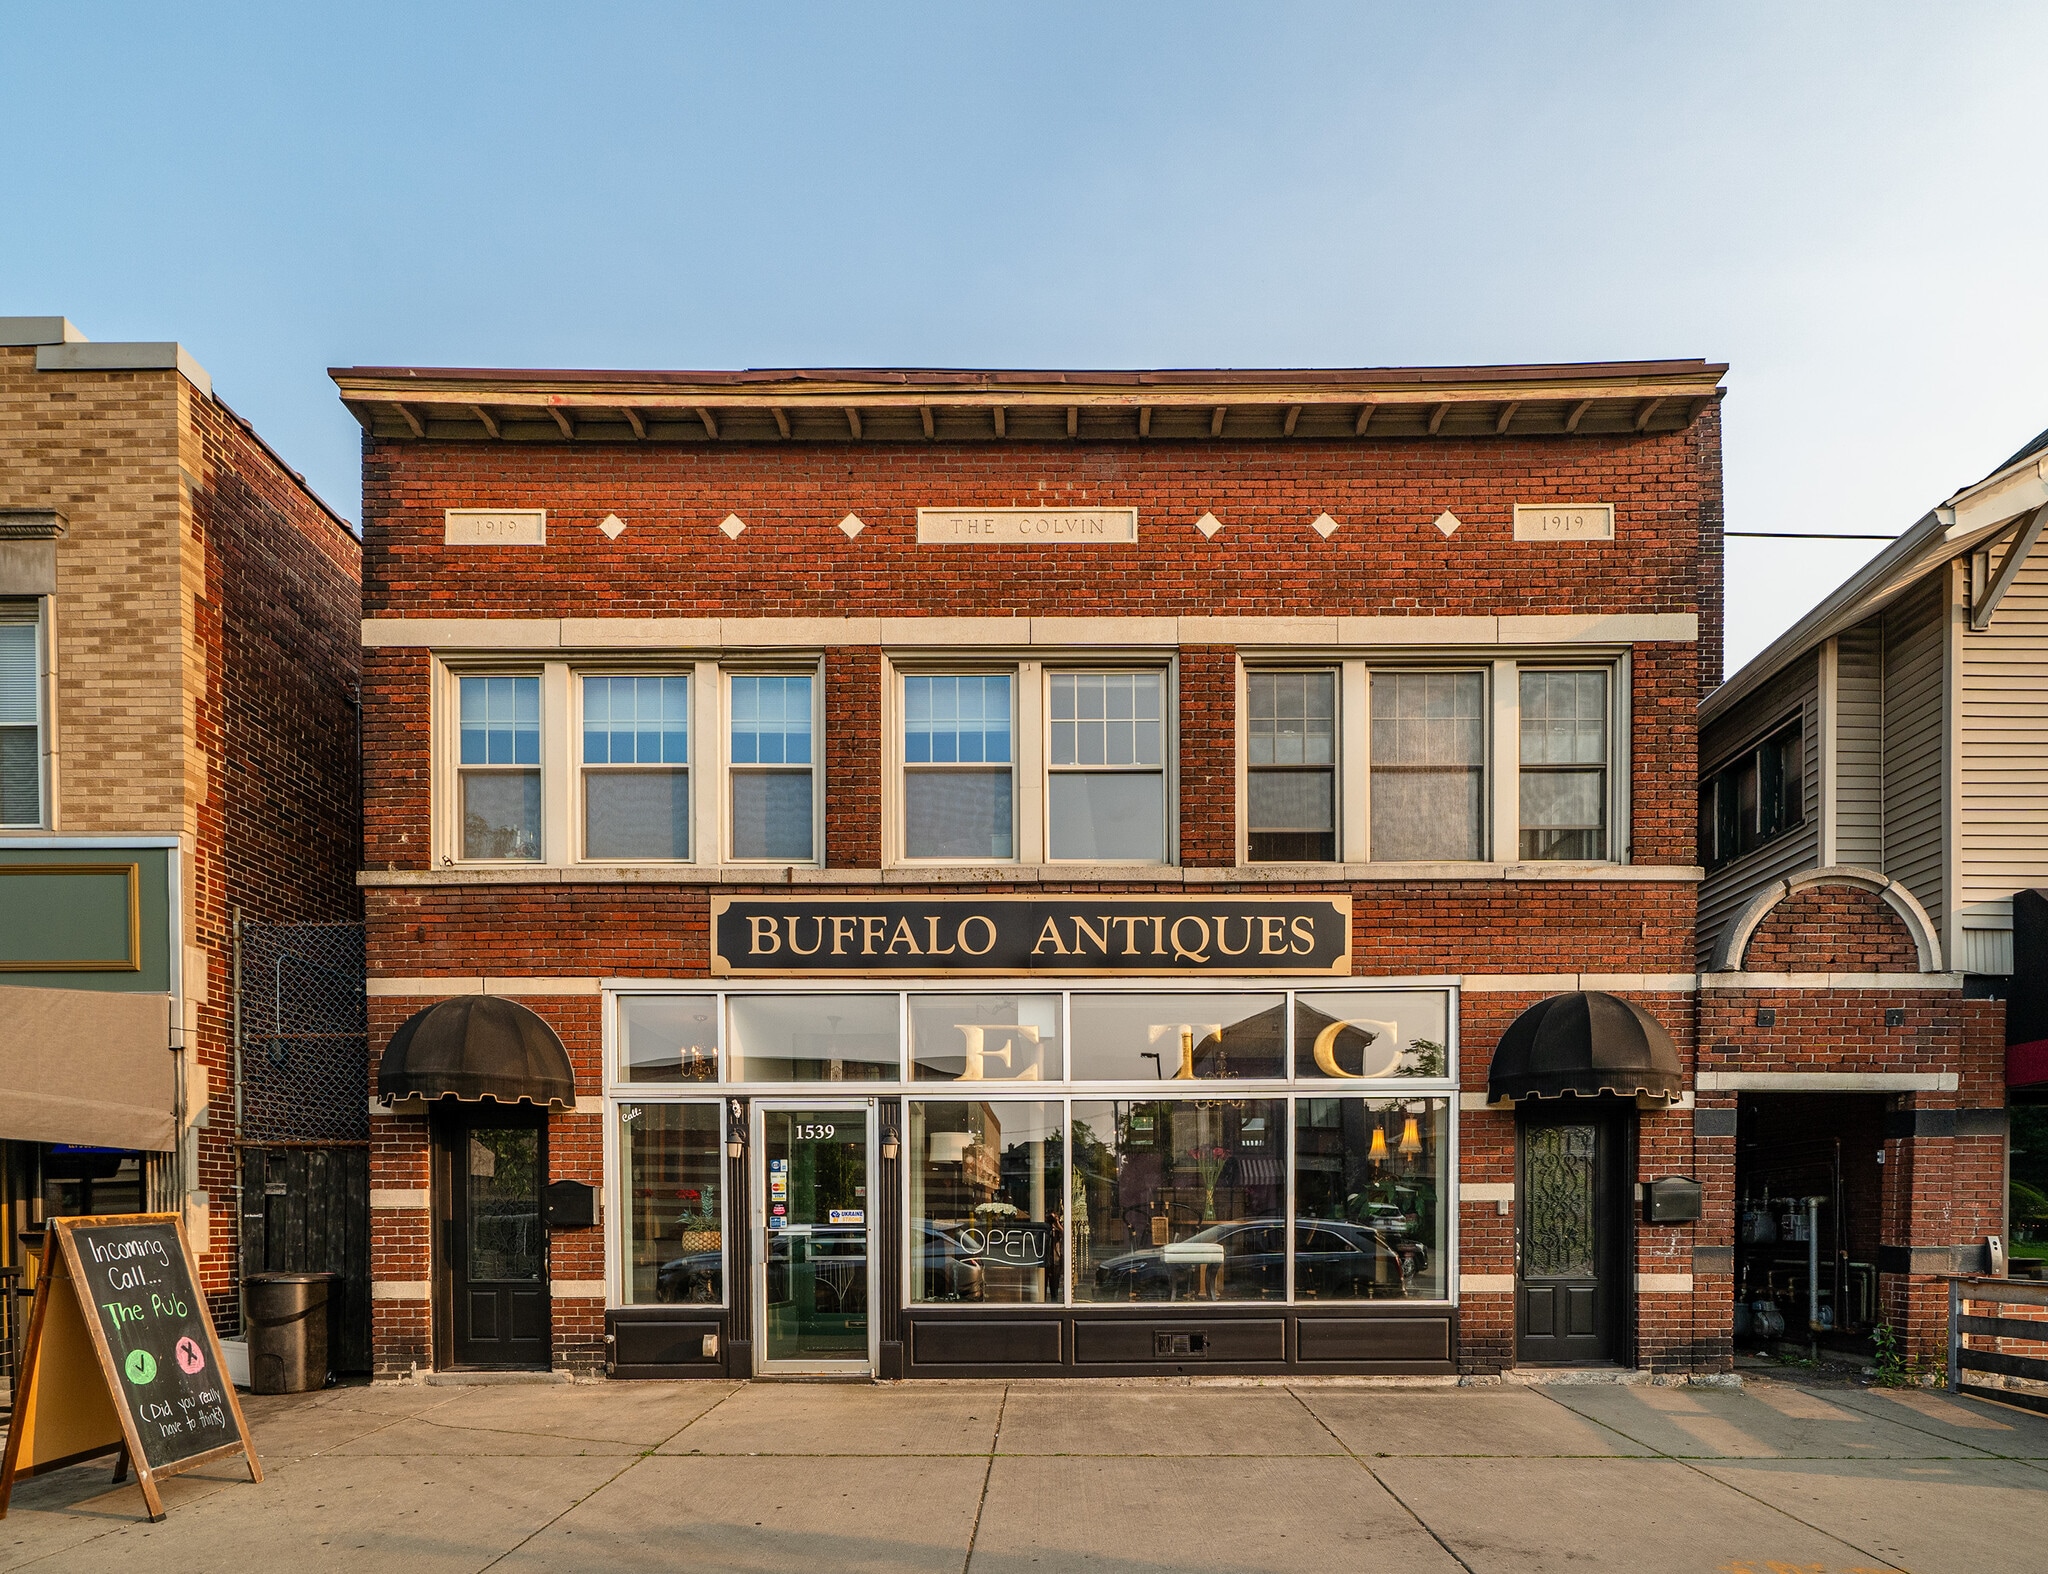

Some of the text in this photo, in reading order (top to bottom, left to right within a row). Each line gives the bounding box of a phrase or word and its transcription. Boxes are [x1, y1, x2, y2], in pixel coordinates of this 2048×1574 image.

[476, 521, 517, 536] 1919
[950, 518, 1105, 534] THE COLVIN
[1542, 516, 1583, 531] 1919
[745, 914, 1316, 964] BUFFALO ANTIQUES
[621, 1107, 643, 1123] Call:
[795, 1124, 836, 1140] 1539
[88, 1237, 169, 1267] Incoming
[960, 1228, 1046, 1258] OPEN
[102, 1293, 188, 1330] The Pub
[140, 1388, 222, 1422] (Did you really
[159, 1418, 183, 1437] have
[186, 1415, 196, 1431] to
